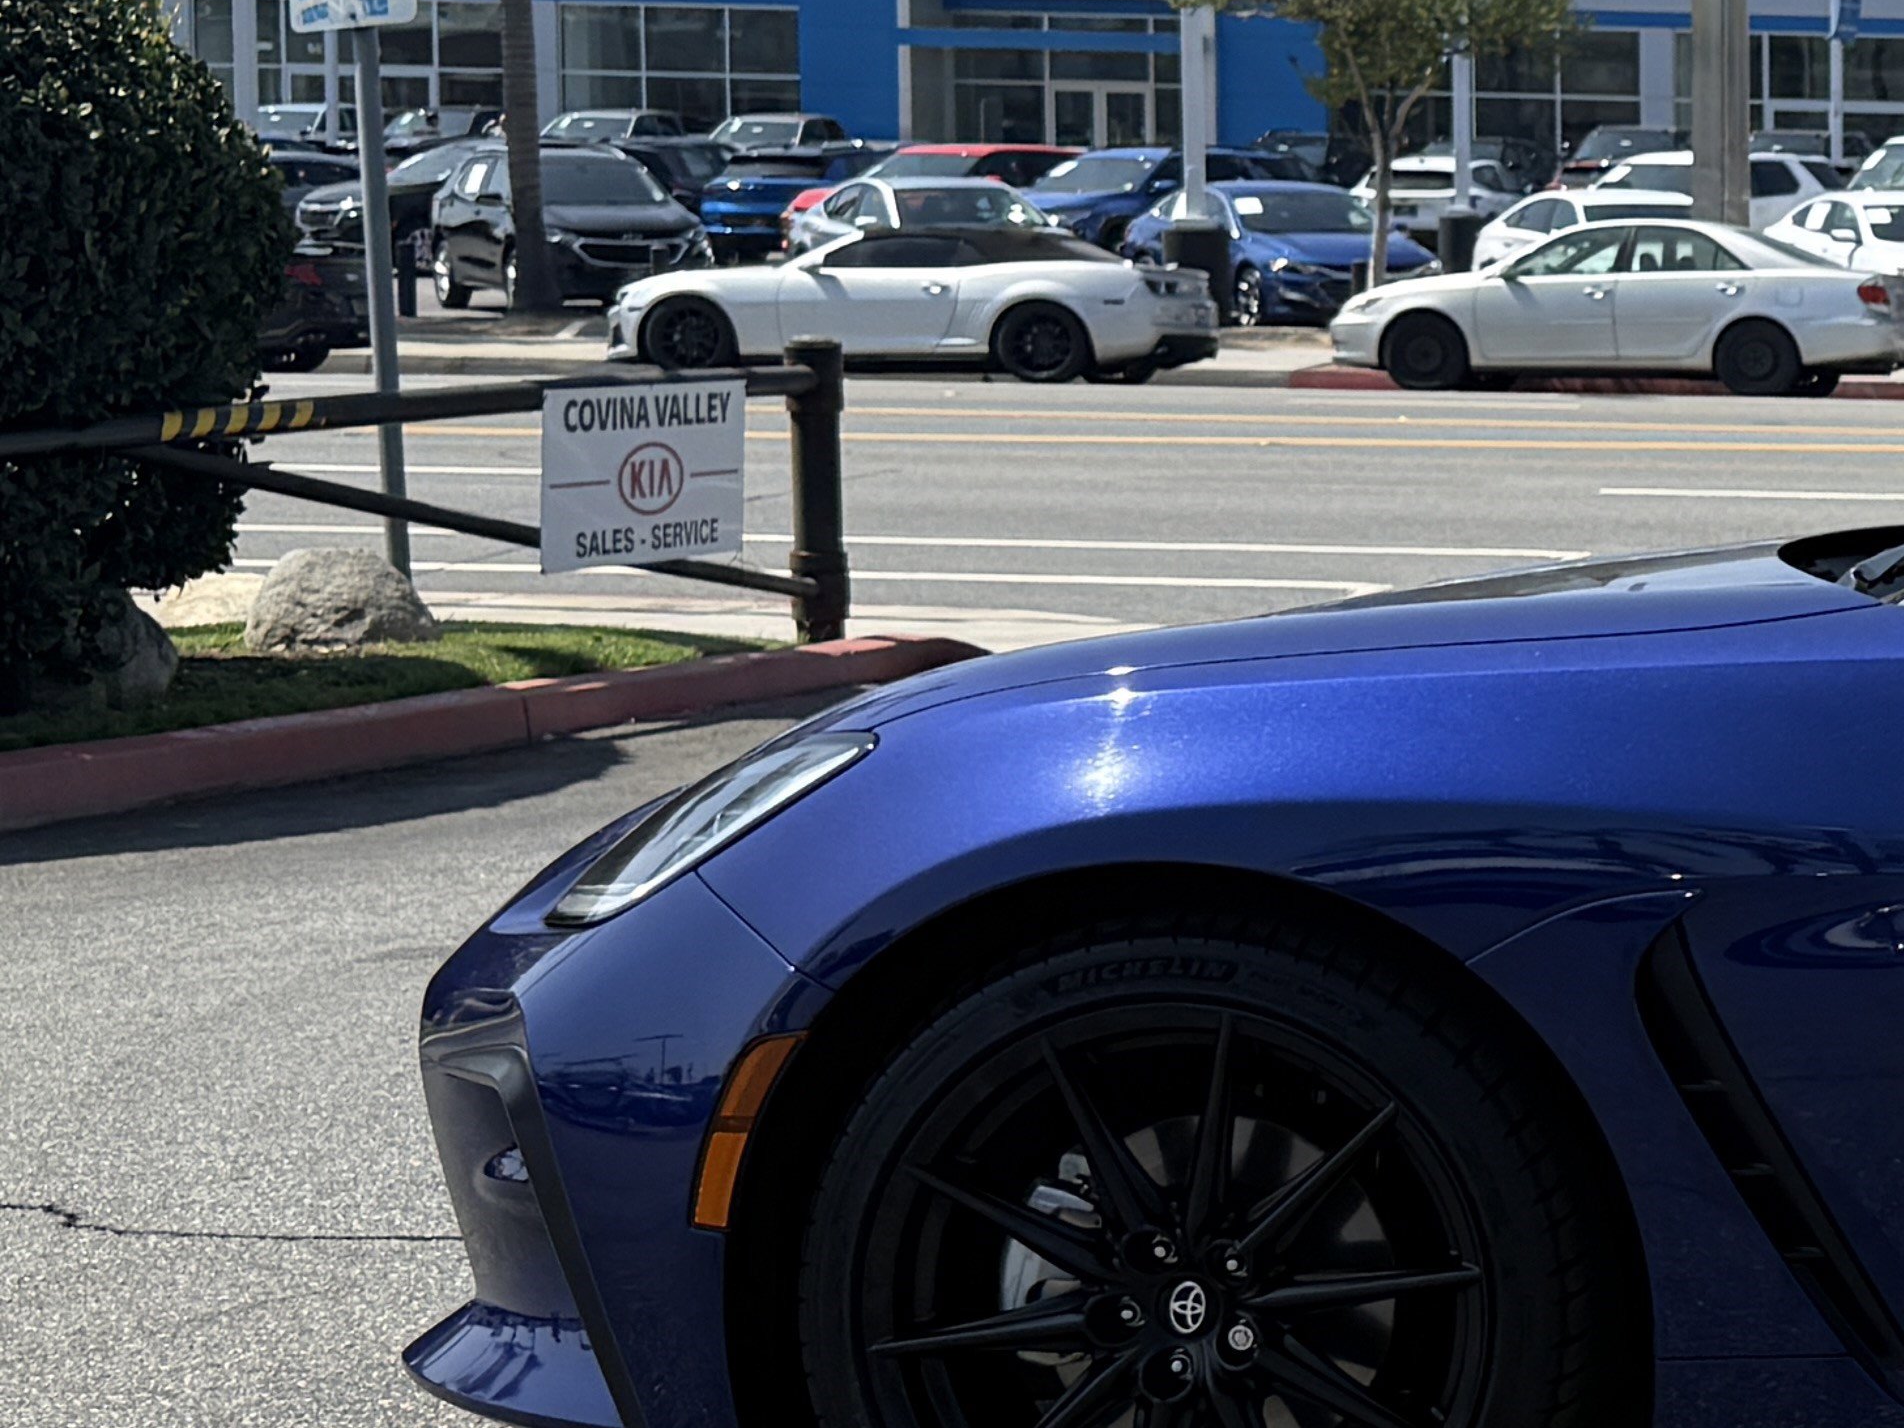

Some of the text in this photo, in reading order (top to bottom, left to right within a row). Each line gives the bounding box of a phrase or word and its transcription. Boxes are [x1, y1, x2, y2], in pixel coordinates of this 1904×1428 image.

[563, 391, 731, 433] COVINA VALLEY
[630, 458, 673, 499] KIA
[576, 527, 635, 558] SALES
[651, 518, 719, 550] SERVICE
[1056, 955, 1237, 993] MICHELIN
